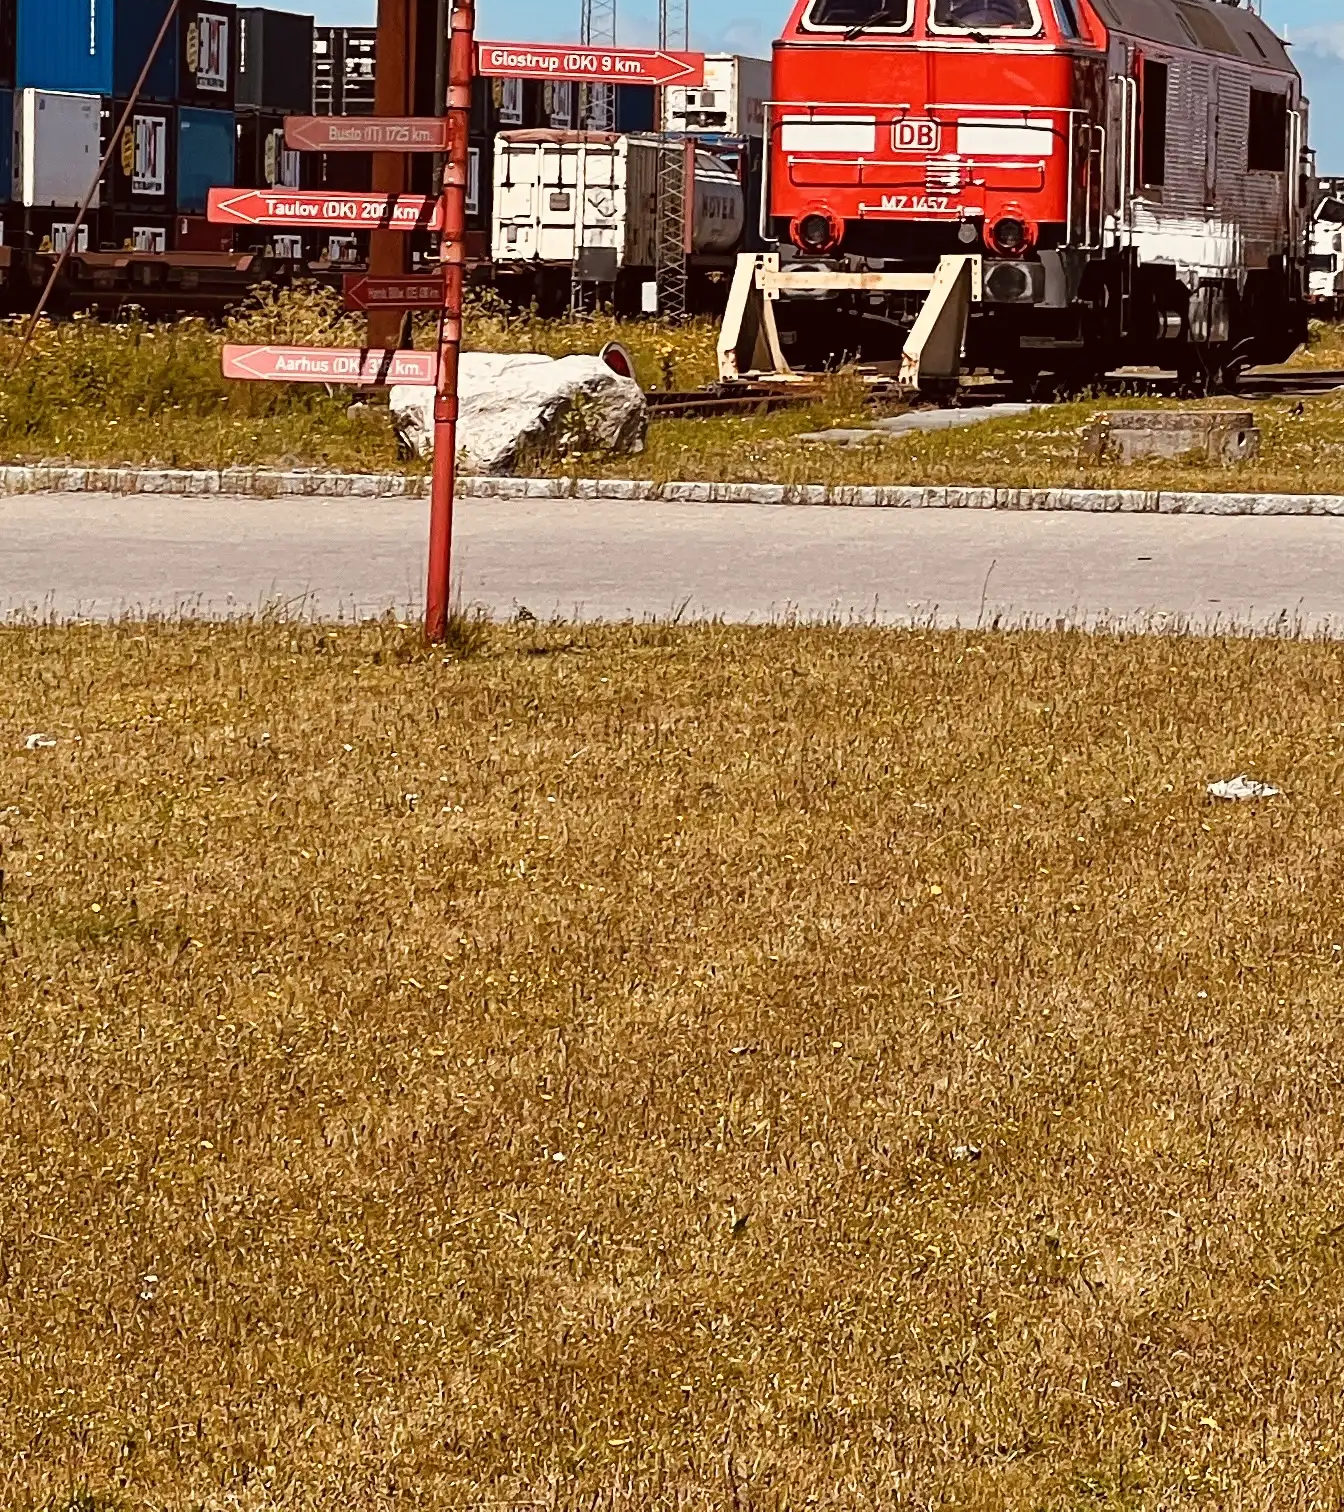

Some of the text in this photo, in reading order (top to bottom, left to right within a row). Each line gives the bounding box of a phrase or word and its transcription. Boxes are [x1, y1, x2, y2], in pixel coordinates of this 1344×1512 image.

[491, 50, 646, 73] Glostrup (DK) 9 km.
[900, 124, 933, 145] DB
[265, 199, 319, 218] Taulov
[322, 201, 357, 219] (DK)
[881, 195, 907, 209] MZ
[275, 355, 329, 374] Aarhus
[395, 361, 424, 376] km.
